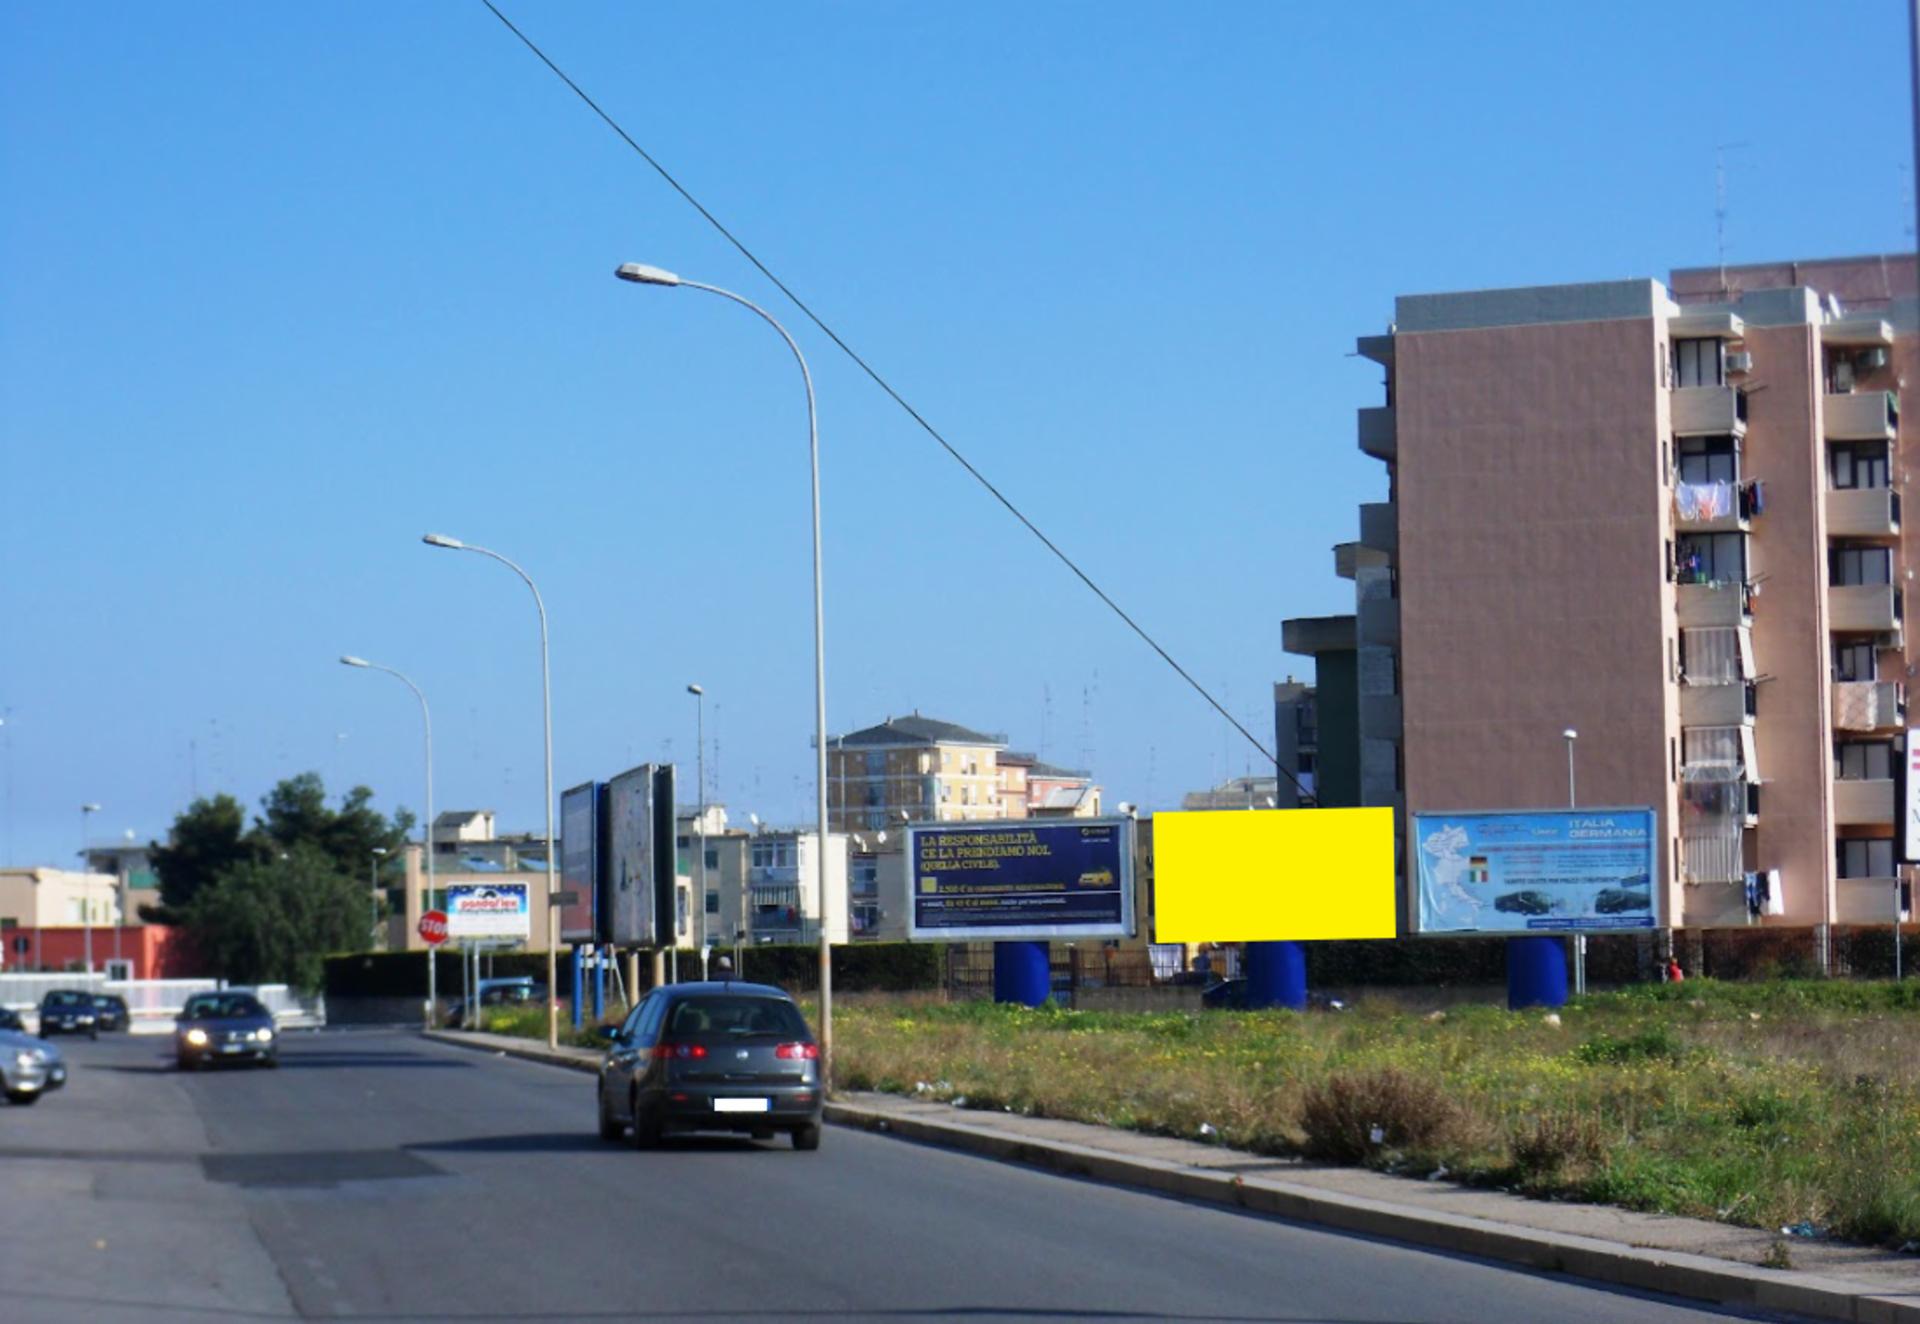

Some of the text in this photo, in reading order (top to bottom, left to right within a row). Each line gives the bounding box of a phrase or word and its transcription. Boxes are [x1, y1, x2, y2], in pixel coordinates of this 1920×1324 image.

[1568, 817, 1616, 829] ITALIA
[1568, 828, 1648, 839] GERMANIA
[920, 836, 937, 847] LA
[920, 848, 937, 859] CE
[938, 848, 956, 859] LA
[956, 845, 1025, 859] PRENDIAMO
[421, 918, 448, 936] STOP
